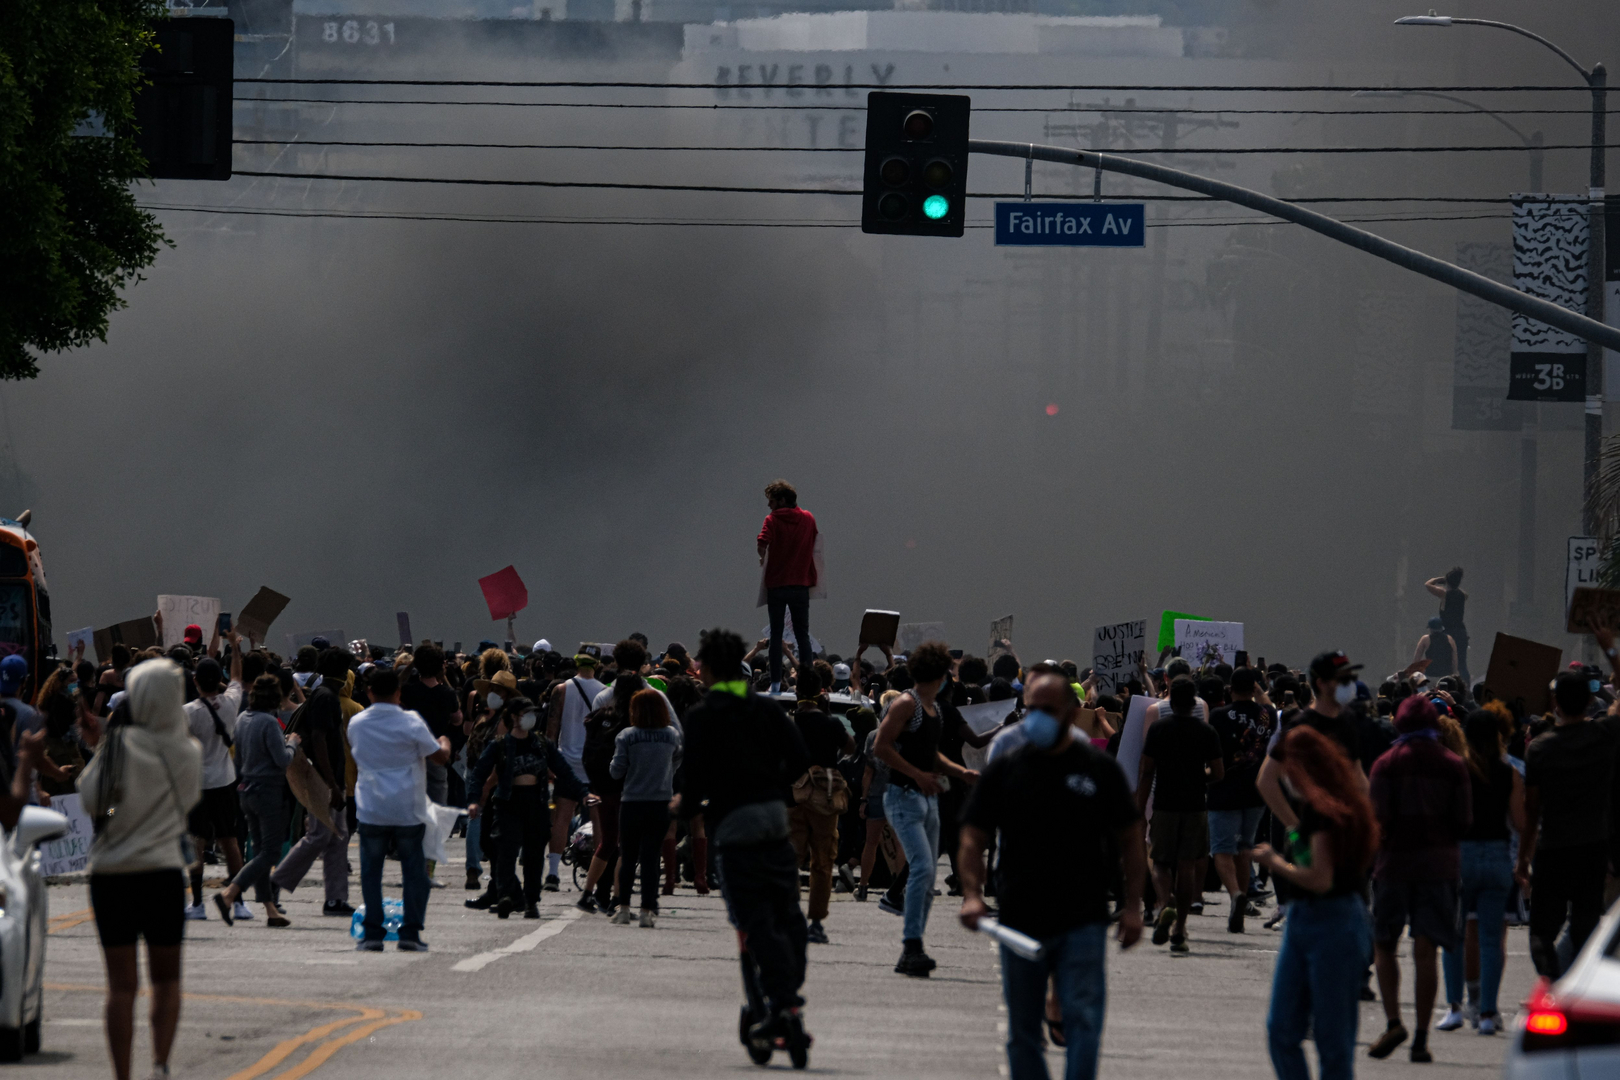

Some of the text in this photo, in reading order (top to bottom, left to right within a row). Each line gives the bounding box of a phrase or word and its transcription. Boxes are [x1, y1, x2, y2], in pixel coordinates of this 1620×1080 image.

[322, 20, 395, 45] 8631
[1009, 211, 1132, 236] Fairfax Av
[1574, 546, 1597, 560] SP
[1098, 621, 1145, 641] JUSTICE
[1227, 709, 1272, 739] CHAOS
